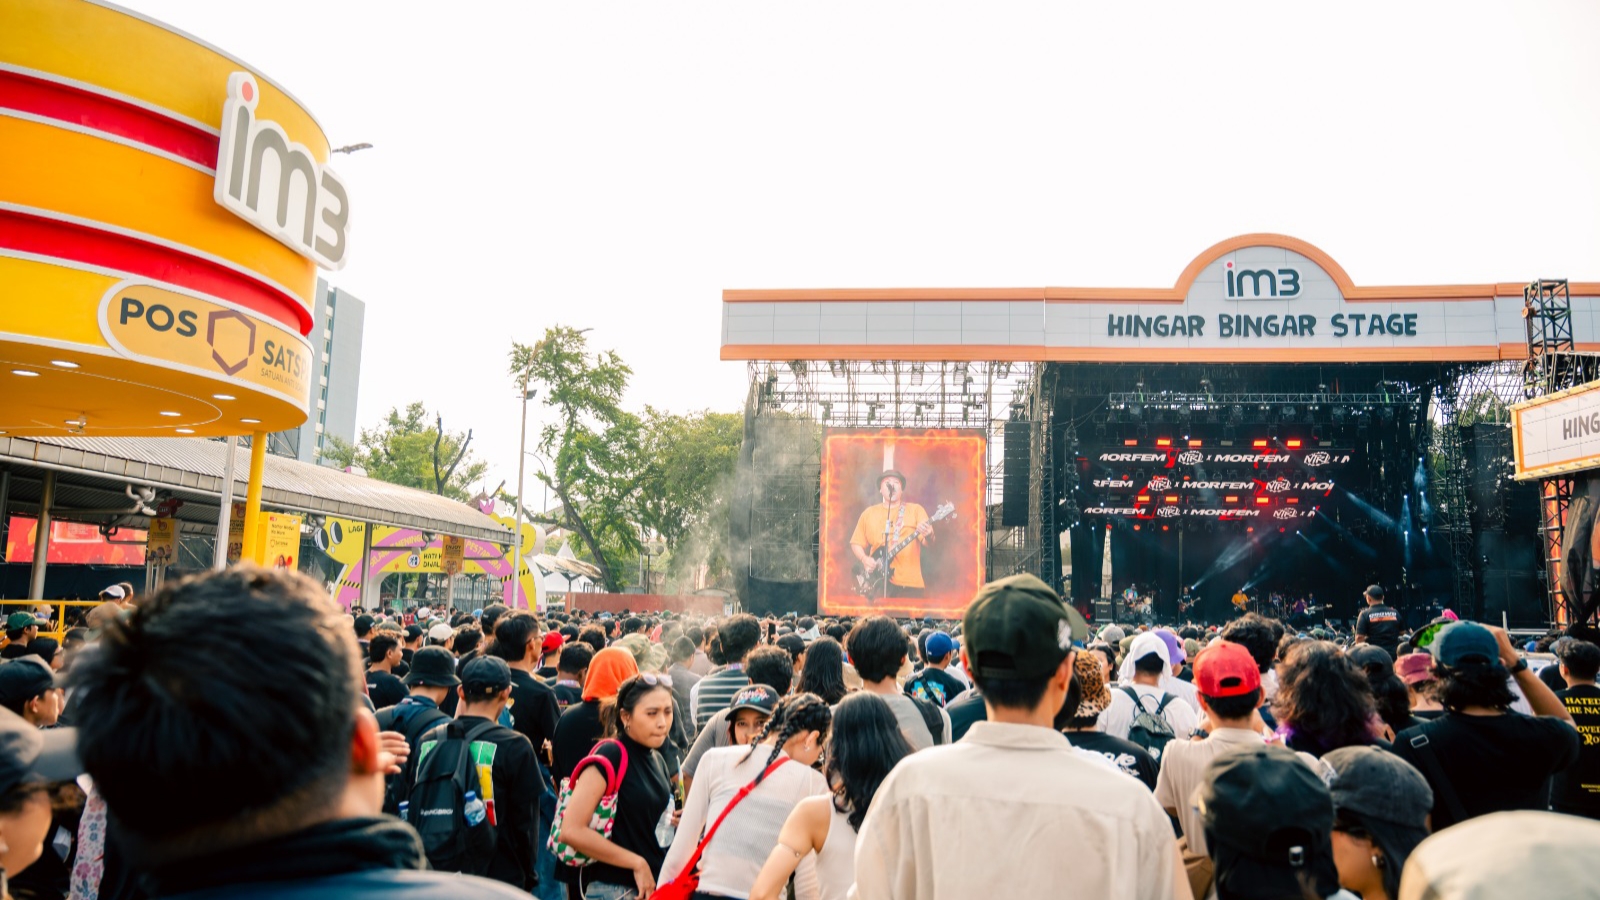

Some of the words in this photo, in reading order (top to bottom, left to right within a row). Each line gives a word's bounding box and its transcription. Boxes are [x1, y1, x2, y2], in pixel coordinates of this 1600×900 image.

[228, 81, 349, 263] im3
[1227, 261, 1300, 297] im3
[119, 297, 198, 337] POS
[1107, 313, 1206, 338] HINGAR
[1218, 314, 1317, 338] BINGAR
[1330, 313, 1418, 338] STAGE
[1214, 454, 1290, 463] MORFEM
[1182, 481, 1254, 489] MORFEM
[1191, 508, 1260, 516] MORFEM
[1584, 707, 1600, 715] NA
